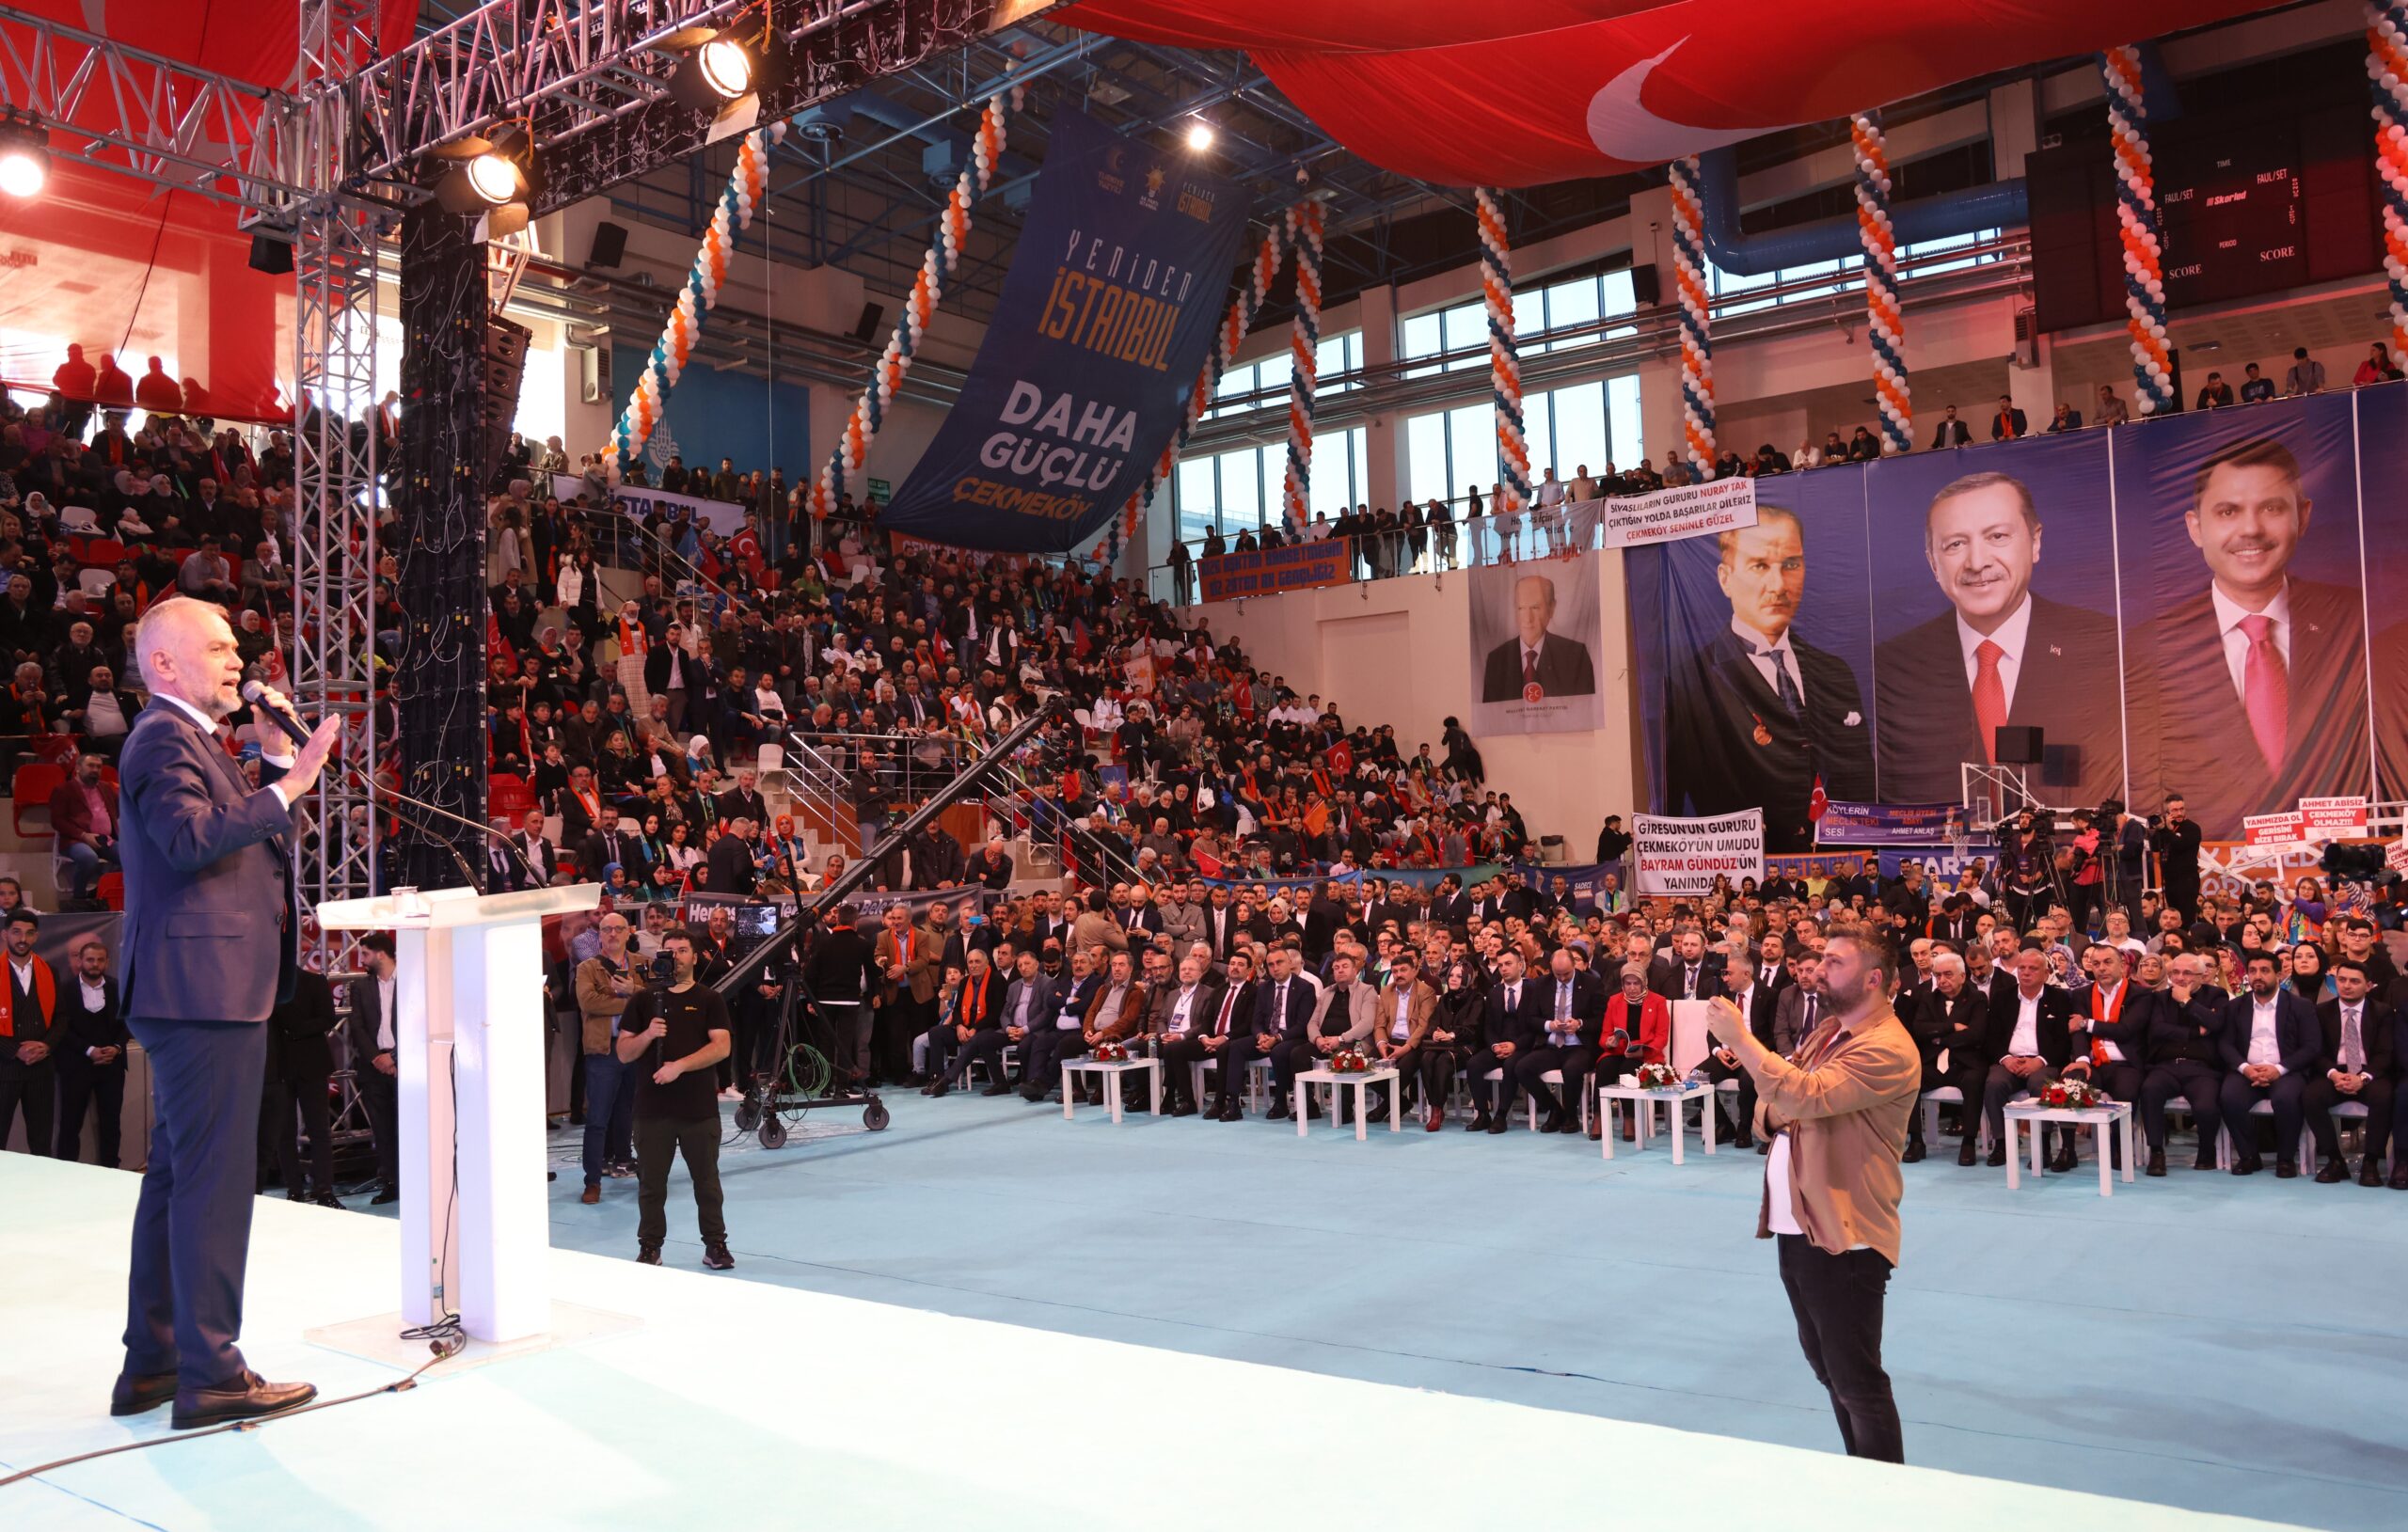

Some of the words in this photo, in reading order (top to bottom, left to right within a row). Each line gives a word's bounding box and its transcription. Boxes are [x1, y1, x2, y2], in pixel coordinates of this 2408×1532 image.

[2217, 159, 2231, 168] TIME
[2258, 168, 2288, 184] FAUL/SET
[2164, 188, 2194, 204] FAUL/SET
[2259, 245, 2295, 262] SCORE
[2169, 263, 2202, 279] SCORE
[1038, 266, 1180, 372] İSTANBUL
[999, 380, 1138, 453] DAHA
[979, 432, 1124, 492] GÜÇLÜ
[952, 476, 1095, 522] ÇEKMEKÖY
[1663, 491, 1698, 506] GURURU
[1700, 485, 1729, 498] NURAY
[1731, 481, 1747, 492] TAK
[1644, 512, 1671, 524] YOLDA
[1672, 502, 1718, 518] BAŞARILAR
[1626, 526, 1668, 543] ÇEKMEKÖY
[1670, 519, 1703, 533] SENİNLE
[1706, 513, 1734, 527] GÜZEL
[1826, 804, 1869, 815] KÖYLERİN
[2302, 799, 2332, 809] AHMET
[2334, 798, 2364, 808] ABİSİZ
[2245, 816, 2289, 827] YANIMIZDA
[2308, 809, 2357, 820] ÇEKMEKÖY
[1639, 819, 1705, 835] GİRESUN'UN
[1708, 818, 1756, 833] GURURU
[1825, 826, 1846, 836] SESİ
[1913, 828, 1935, 836] ANLAŞ
[2258, 825, 2292, 835] GERİSİNİ
[1637, 836, 1714, 858] ÇEKMEKÖY'ÜN
[1718, 837, 1760, 852] UMUDU
[2254, 836, 2273, 845] BİZE
[2273, 833, 2298, 844] BIRAK
[1640, 858, 1684, 872] BAYRAM
[1687, 854, 1757, 871] GÜNDÜZ'ÜN
